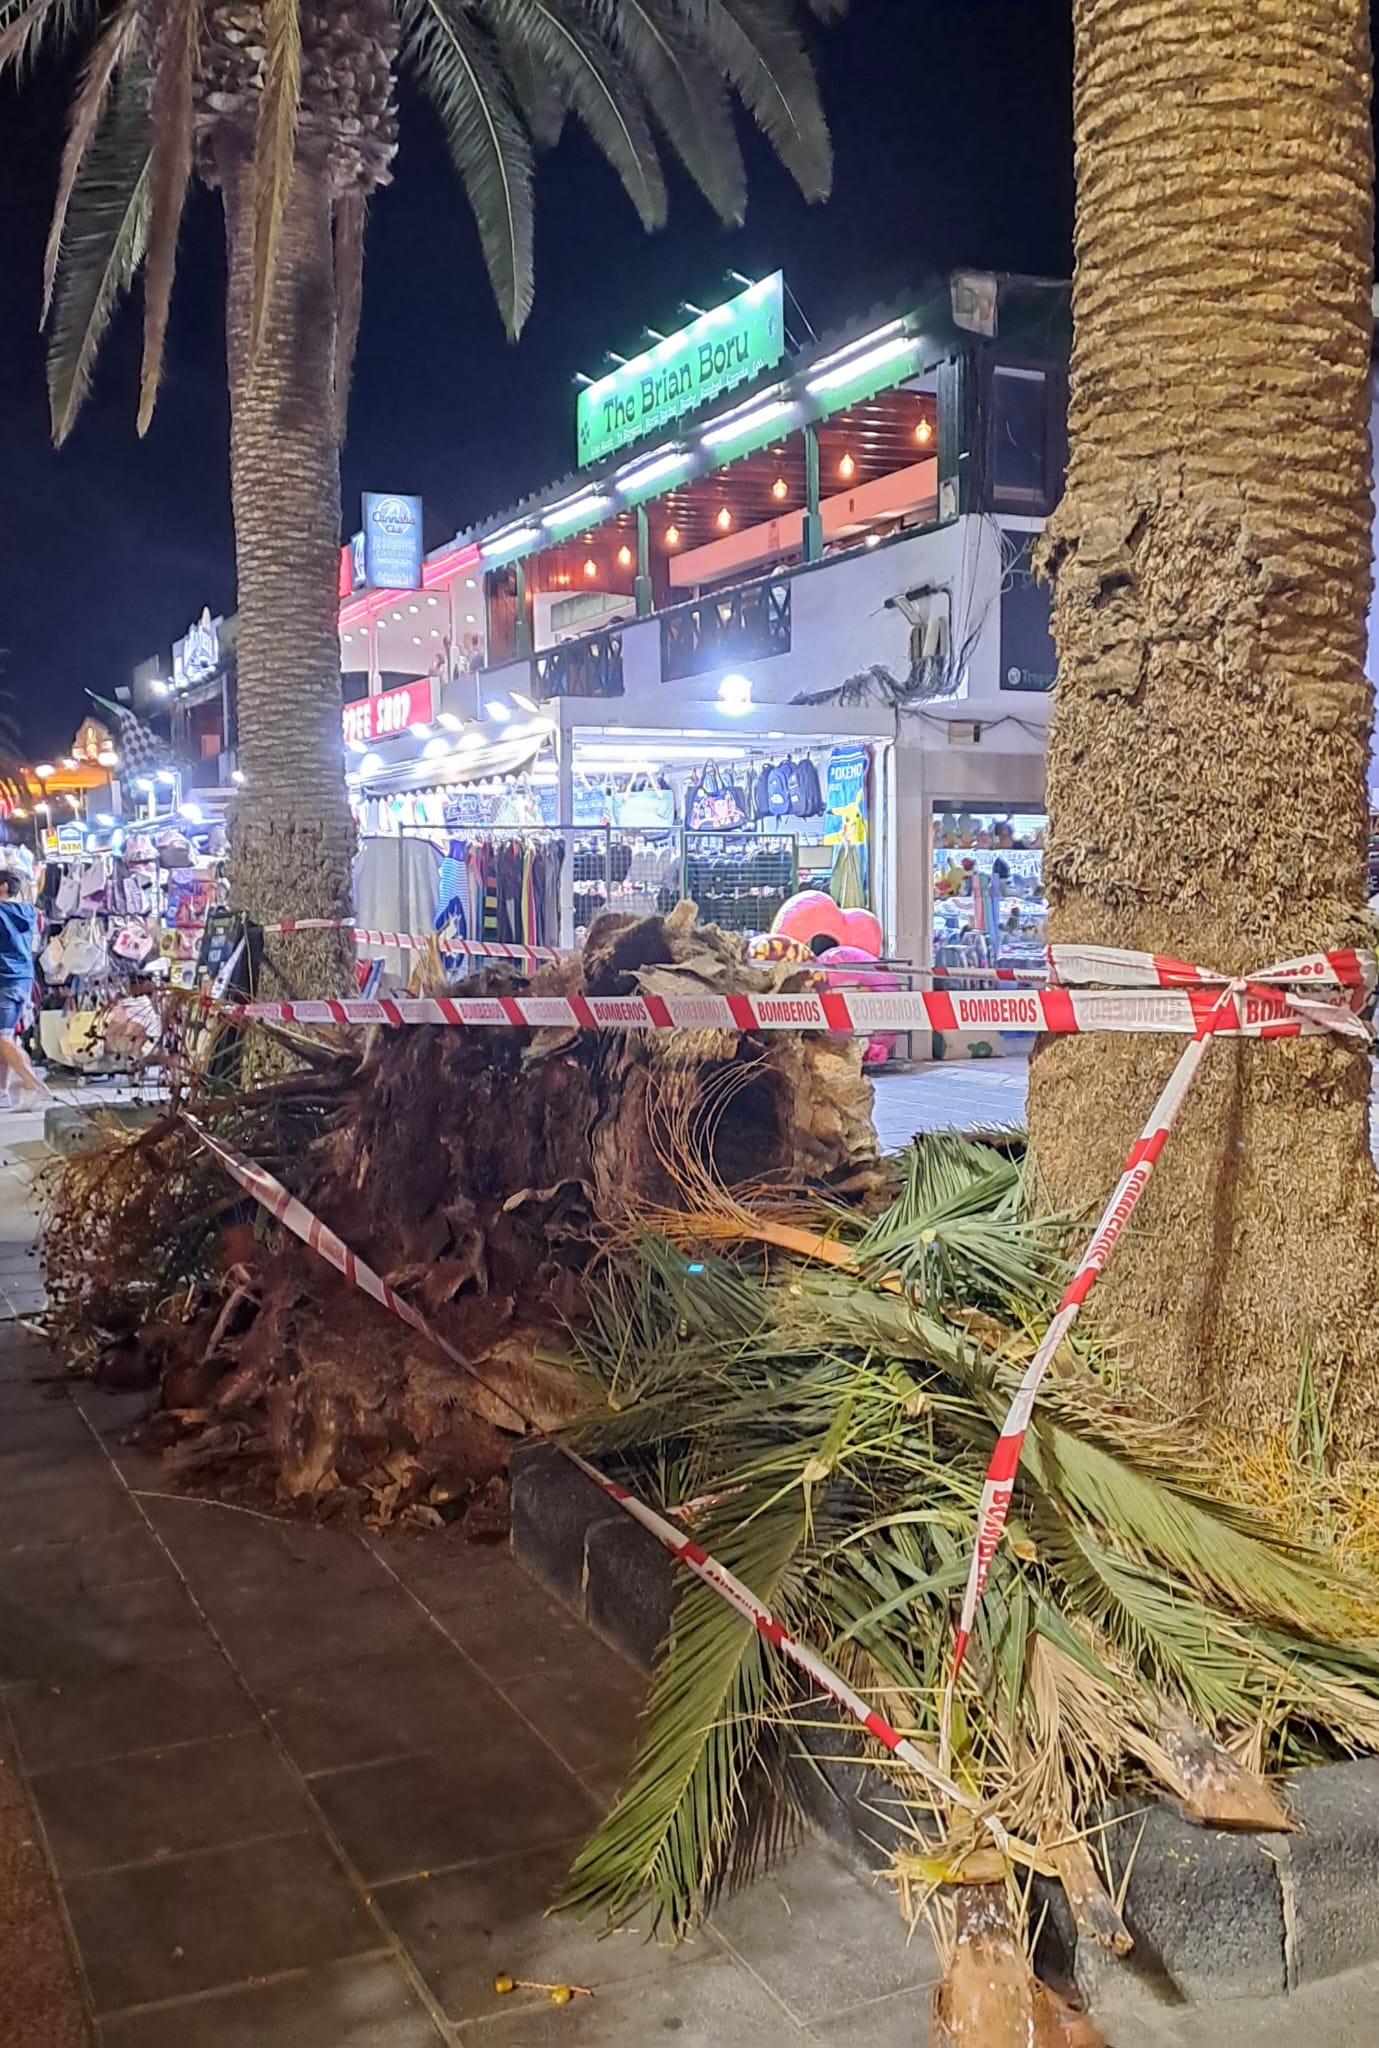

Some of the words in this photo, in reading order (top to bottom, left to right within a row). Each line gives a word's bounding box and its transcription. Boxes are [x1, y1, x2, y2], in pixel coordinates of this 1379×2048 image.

[603, 392, 635, 433] The
[640, 362, 692, 414] Brian
[699, 330, 749, 382] Boru
[372, 511, 416, 526] Cannabis
[385, 525, 403, 534] Club
[376, 690, 410, 734] SHOP
[61, 843, 81, 851] ATM
[593, 1002, 647, 1021] BOMBEROS
[757, 1000, 820, 1022] BOMBEROS
[959, 998, 1038, 1023] BOMBEROS
